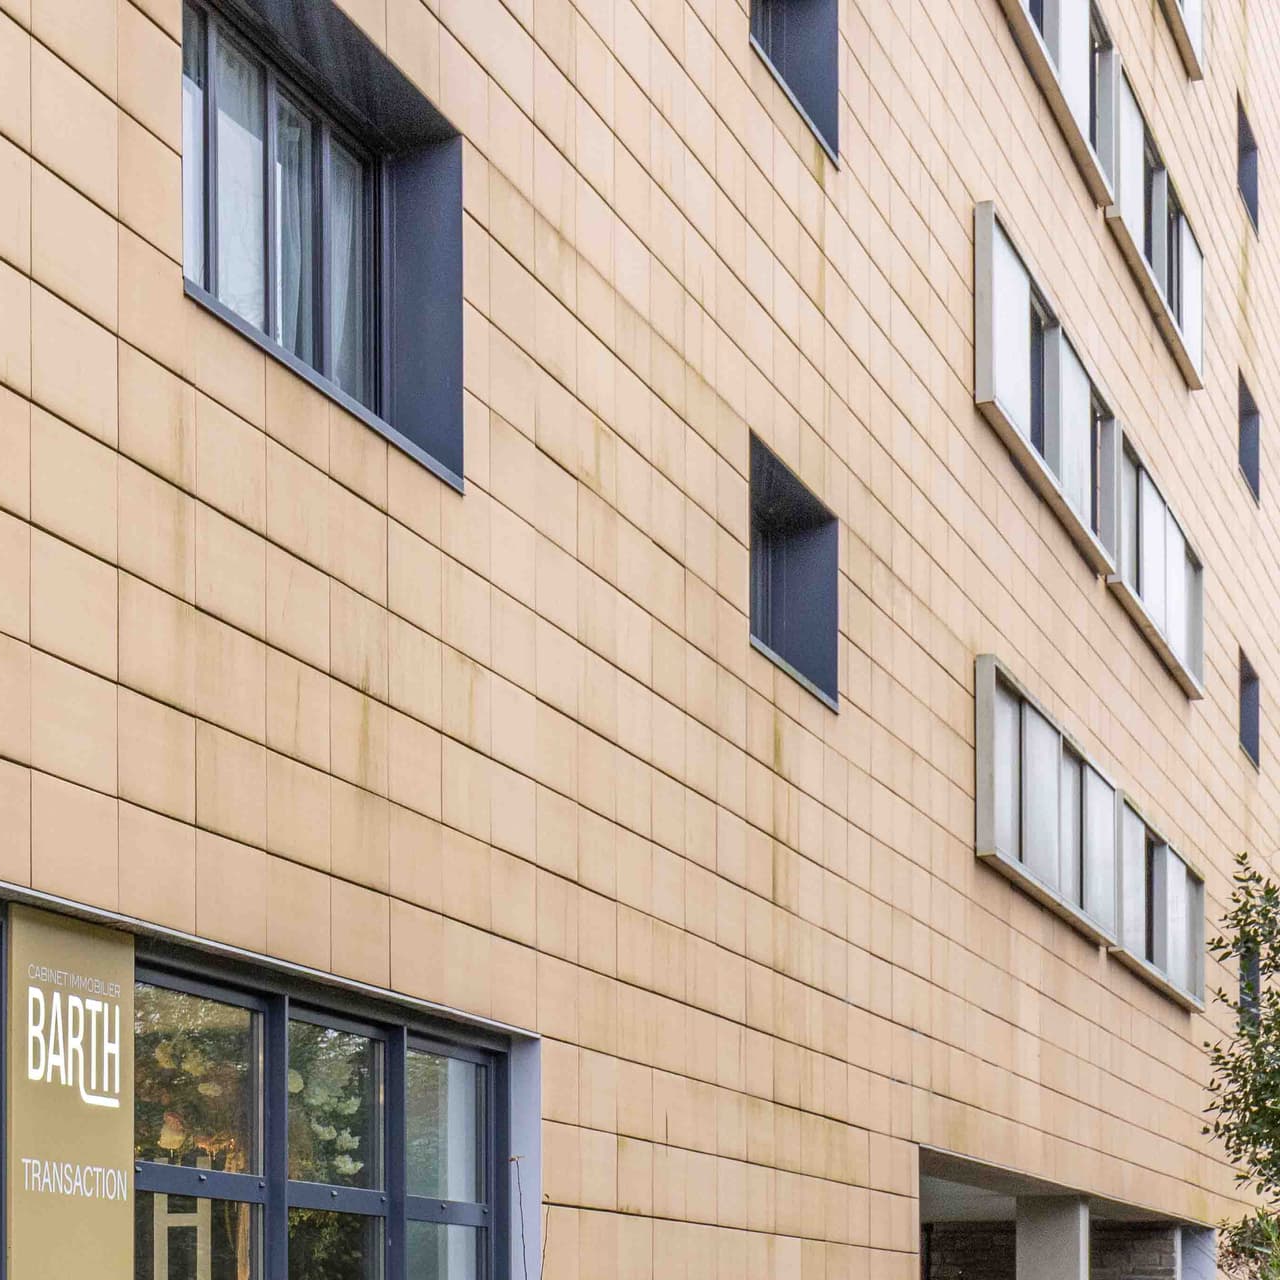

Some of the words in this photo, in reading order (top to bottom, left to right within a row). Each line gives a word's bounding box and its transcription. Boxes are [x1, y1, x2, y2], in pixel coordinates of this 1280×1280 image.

[28, 963, 67, 986] CABINET
[69, 973, 121, 998] IMMOBILIER
[27, 985, 120, 1108] BARTH
[21, 1158, 127, 1201] TRANSACTION
